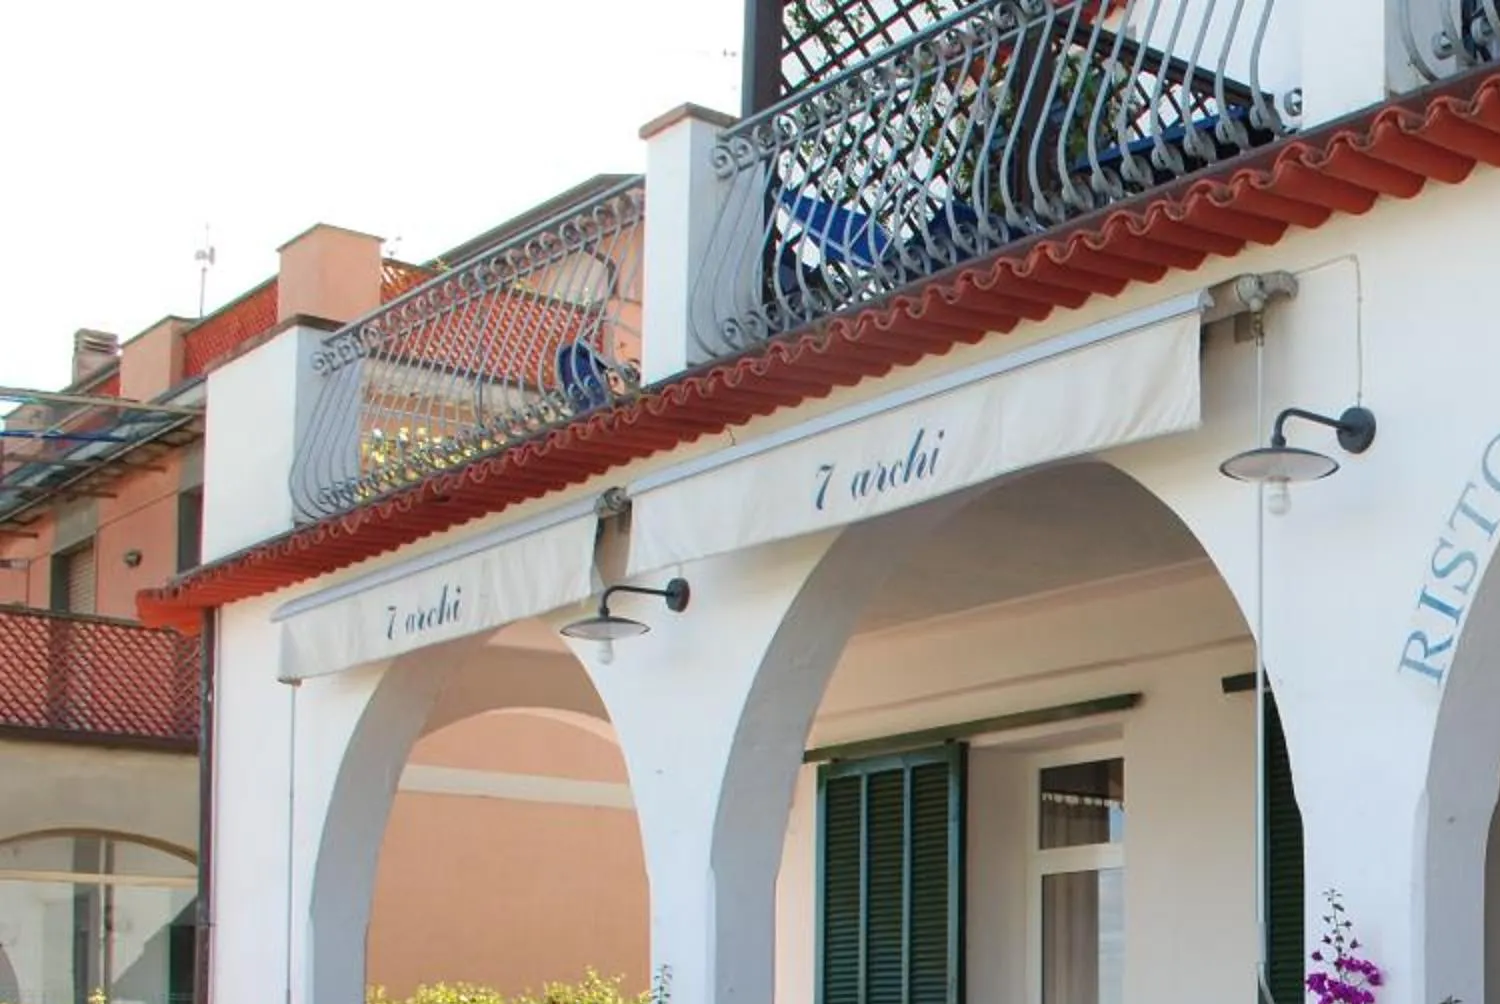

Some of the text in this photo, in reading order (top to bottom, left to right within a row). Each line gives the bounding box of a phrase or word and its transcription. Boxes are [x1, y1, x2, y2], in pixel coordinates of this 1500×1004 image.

[815, 427, 945, 511] 7 archi
[386, 583, 462, 640] 7 archi
